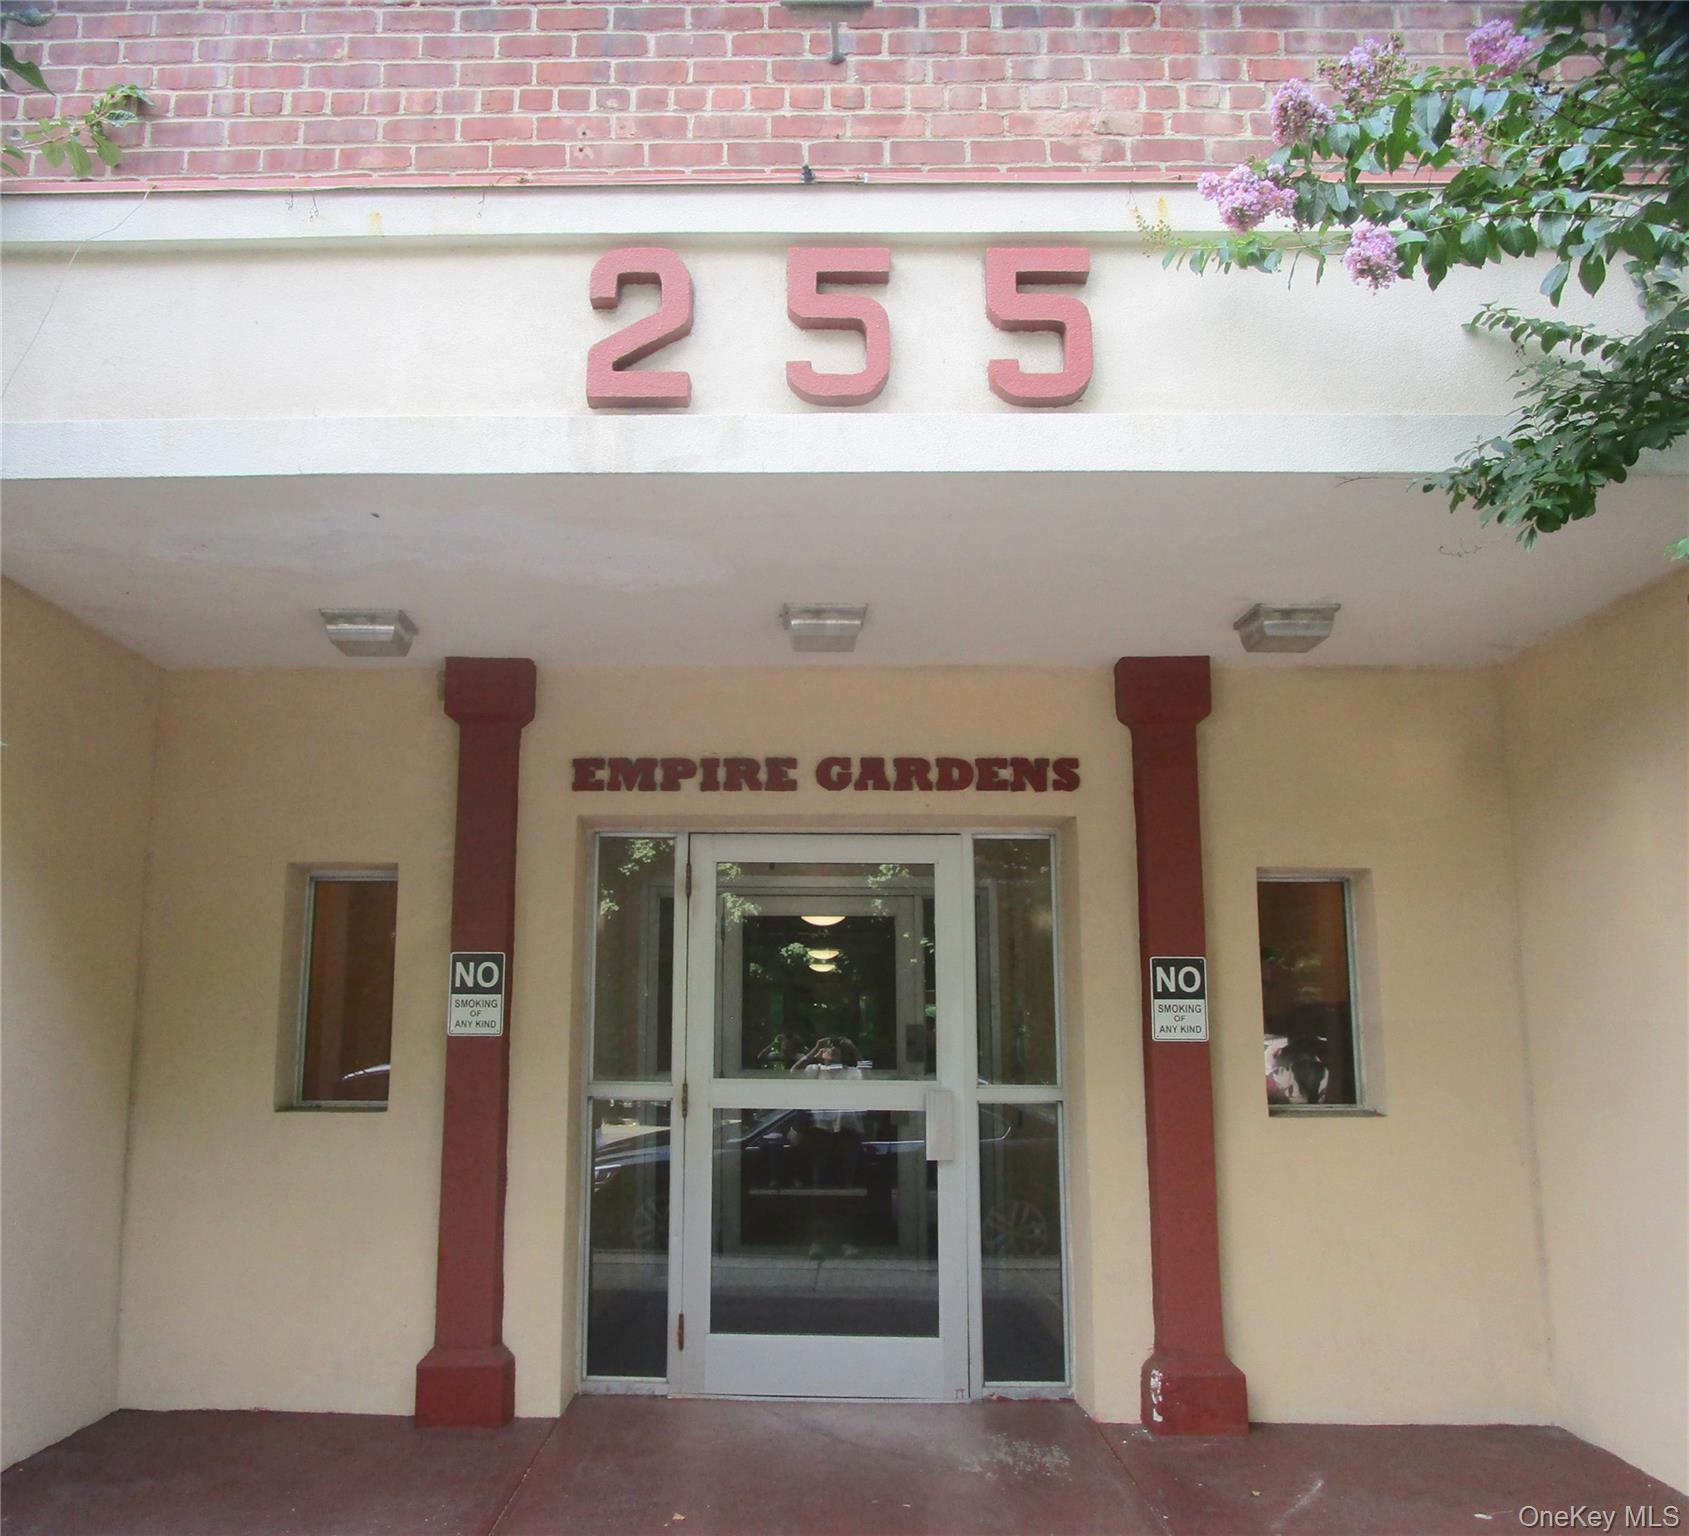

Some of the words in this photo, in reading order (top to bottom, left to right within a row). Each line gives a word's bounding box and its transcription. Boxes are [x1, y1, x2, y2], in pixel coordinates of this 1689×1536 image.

[586, 247, 1094, 410] 255
[571, 757, 798, 792] EMPIRE
[815, 756, 1081, 792] GARDENS
[455, 961, 500, 988] NO
[1156, 966, 1201, 993] NO
[454, 999, 498, 1009] SMOKING
[1157, 1004, 1202, 1014] SMOKING
[455, 1020, 473, 1028] ANY
[475, 1020, 497, 1029] KIND
[1159, 1025, 1178, 1033] ANY
[1180, 1025, 1202, 1034] KIND
